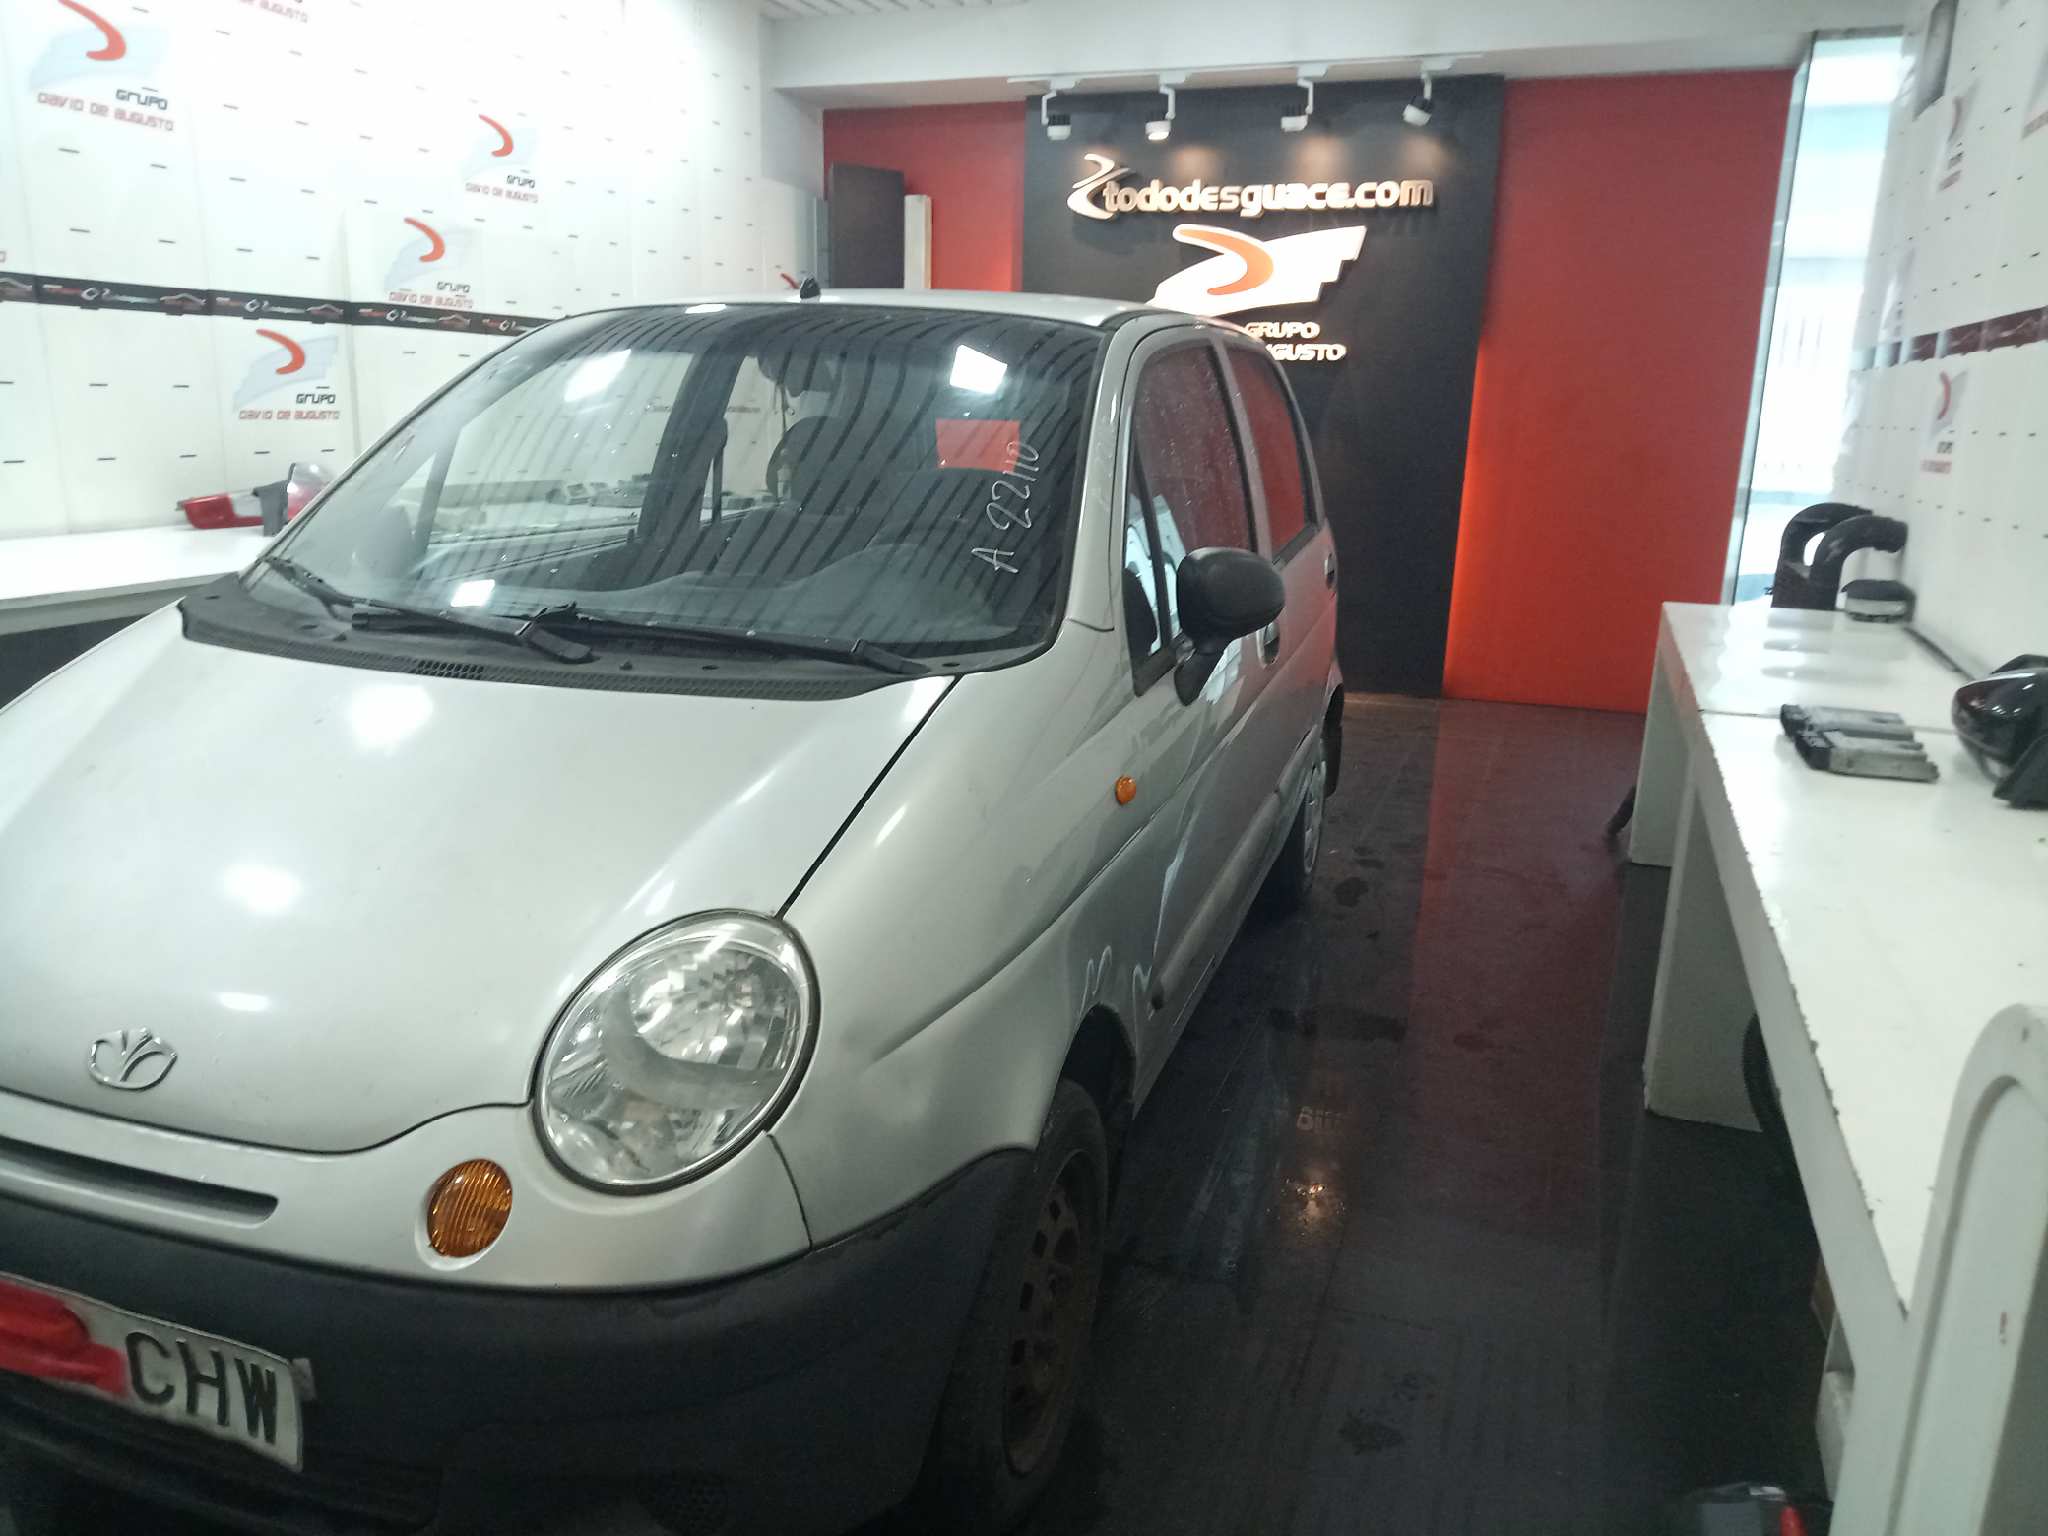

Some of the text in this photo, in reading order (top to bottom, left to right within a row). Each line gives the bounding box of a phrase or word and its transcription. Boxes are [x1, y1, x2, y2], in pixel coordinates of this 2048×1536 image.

[1102, 178, 1434, 218] tododesguace.com
[1245, 321, 1321, 339] GRUPO
[1263, 343, 1347, 361] GUSTO
[971, 547, 1019, 573] A
[126, 1331, 278, 1445] CHW
